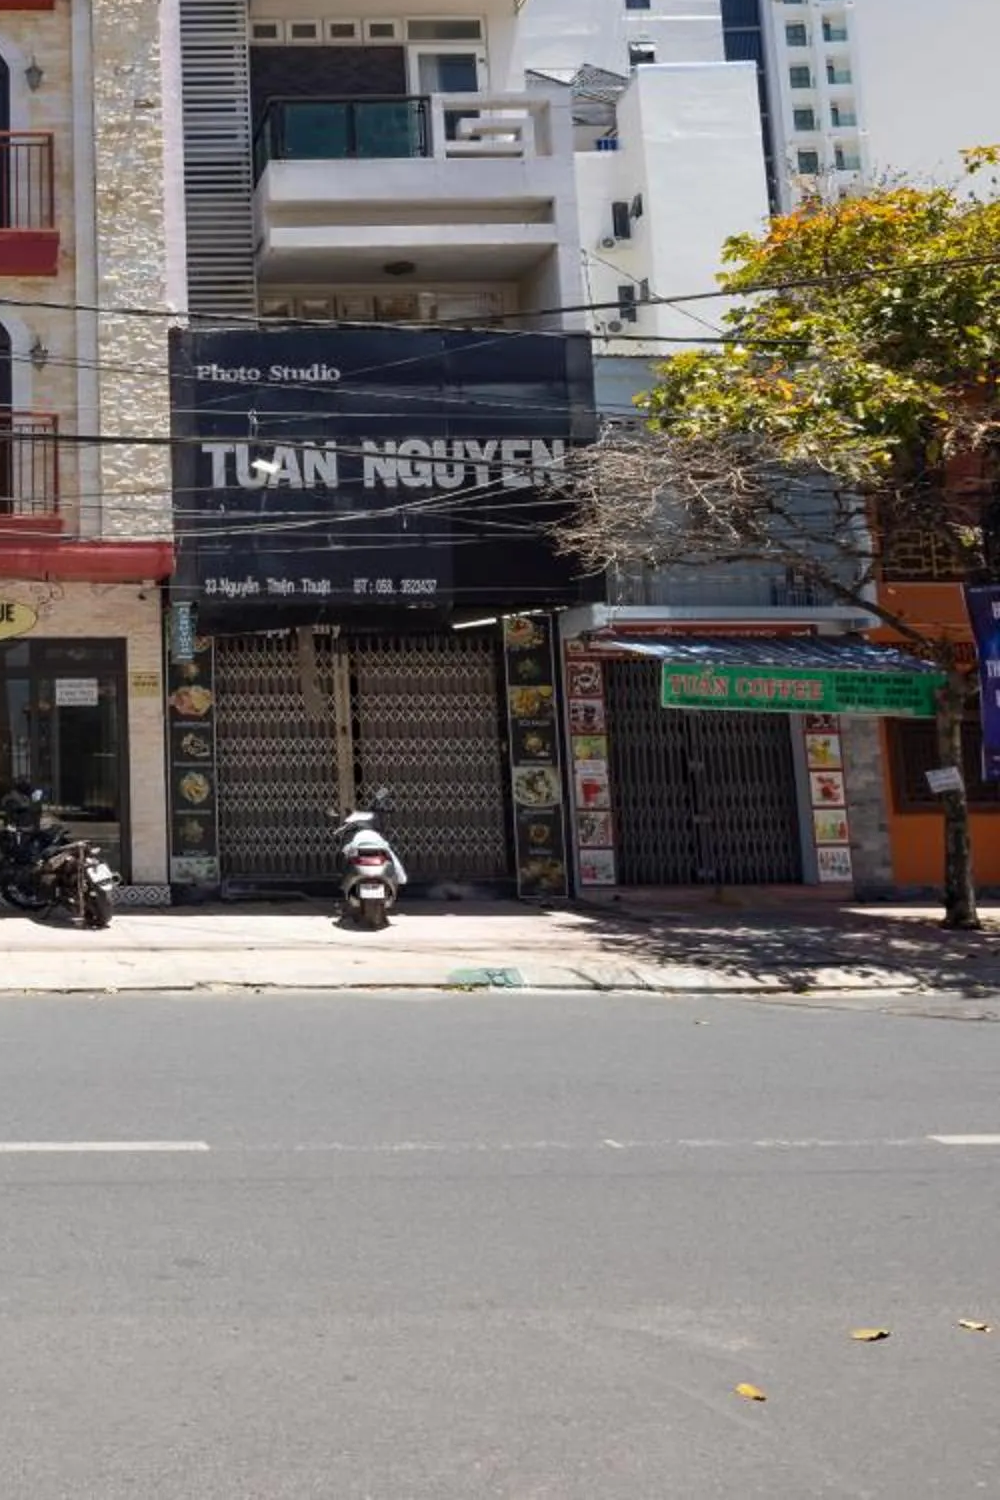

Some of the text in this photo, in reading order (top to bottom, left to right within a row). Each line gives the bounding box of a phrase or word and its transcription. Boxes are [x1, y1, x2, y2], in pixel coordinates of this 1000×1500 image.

[196, 364, 340, 382] Photo Studio
[736, 677, 824, 700] COFFEE
